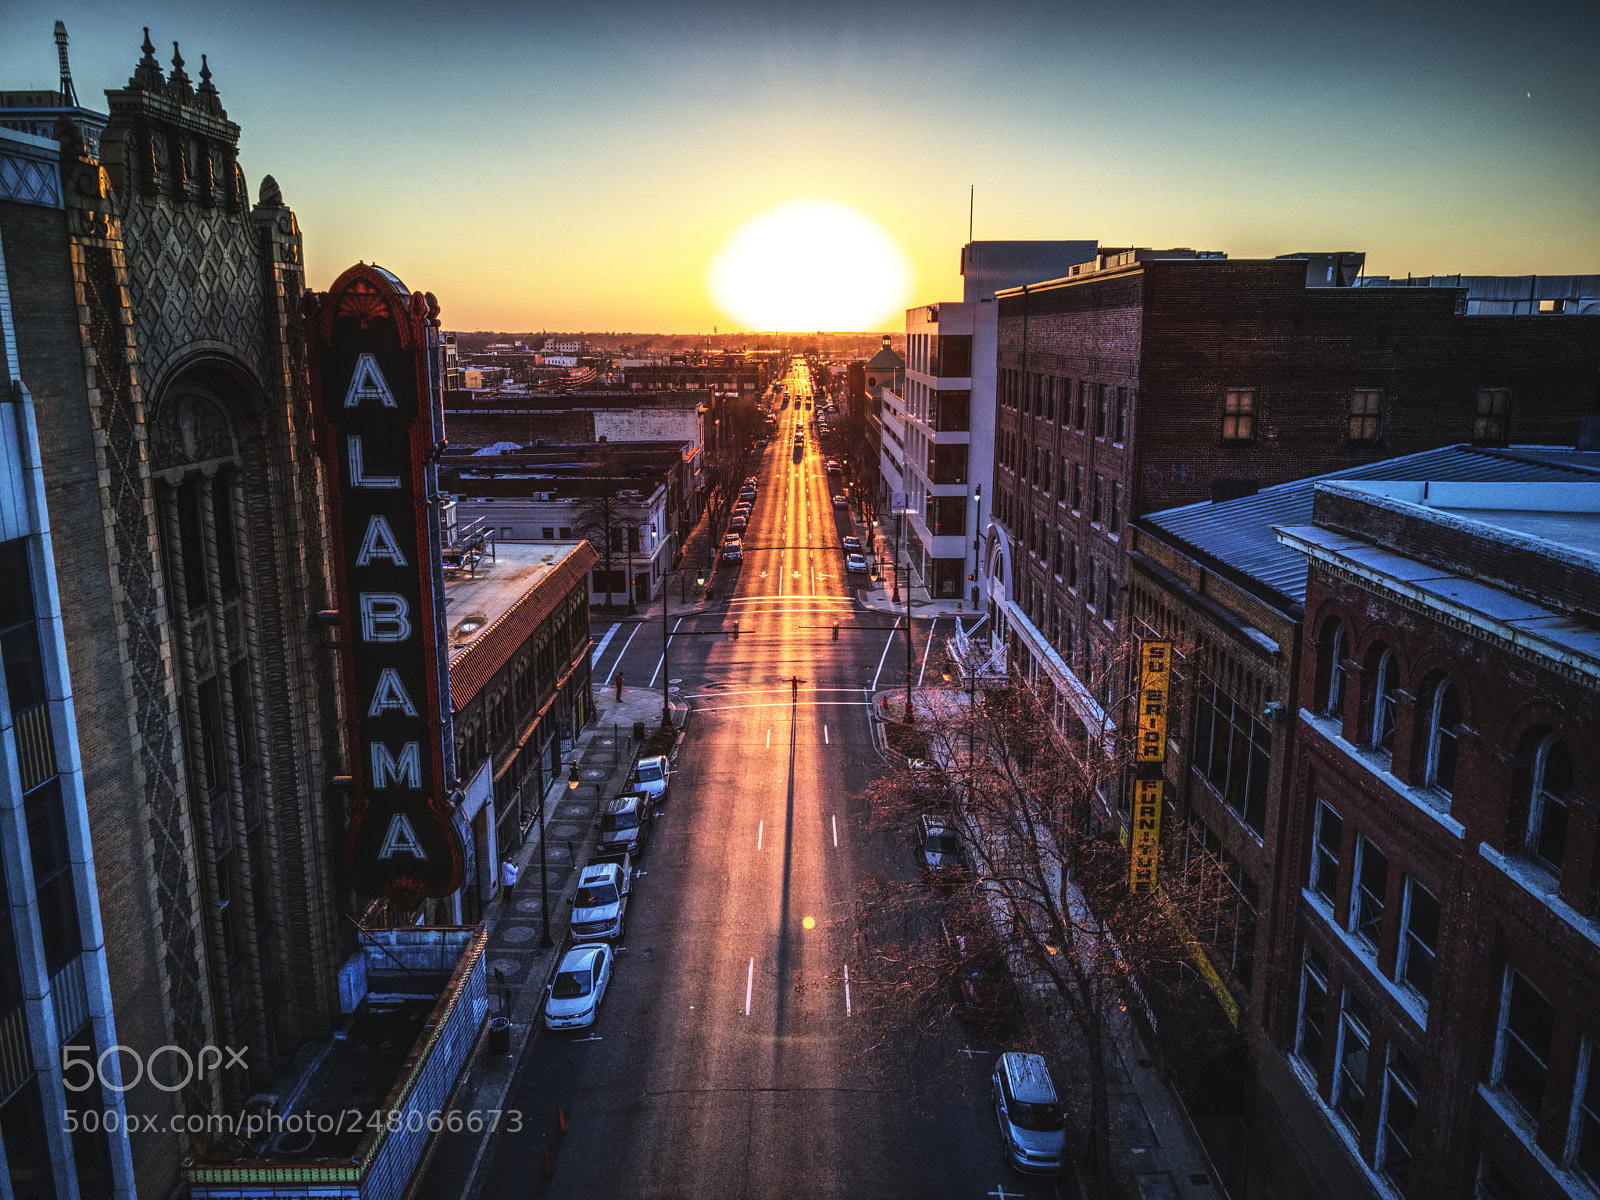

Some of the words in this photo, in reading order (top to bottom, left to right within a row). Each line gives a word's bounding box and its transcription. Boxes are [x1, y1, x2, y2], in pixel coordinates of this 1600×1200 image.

[343, 352, 428, 861] ALABAMA
[1143, 646, 1166, 757] SUERIOR
[1135, 781, 1158, 892] FURNITURE
